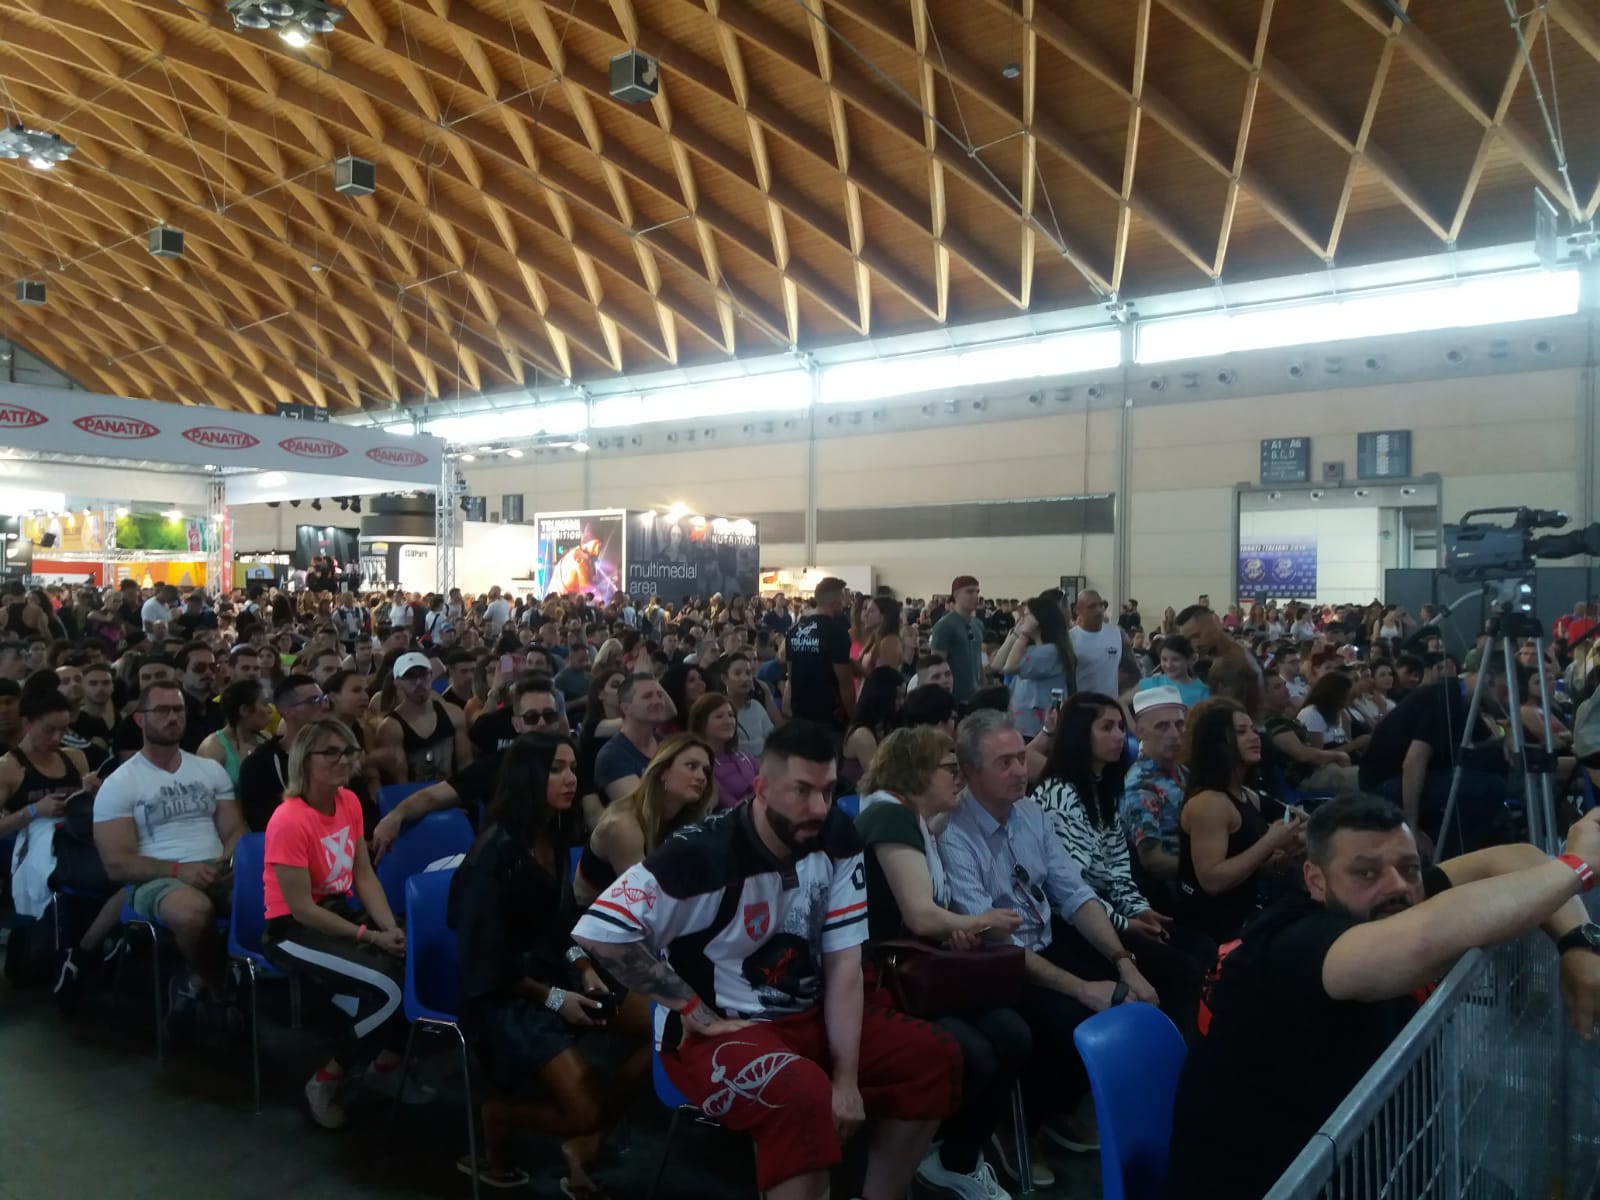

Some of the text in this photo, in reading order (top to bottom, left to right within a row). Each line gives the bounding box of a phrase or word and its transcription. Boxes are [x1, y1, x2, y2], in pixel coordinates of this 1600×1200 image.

[84, 417, 152, 435] PANATTA
[191, 429, 251, 446] PANATTA
[287, 440, 341, 457] PANATTA
[374, 449, 419, 465] PANATTA
[712, 534, 756, 545] NUTRITION
[629, 561, 698, 579] multimedial
[629, 581, 657, 594] area
[161, 793, 210, 819] GUESS
